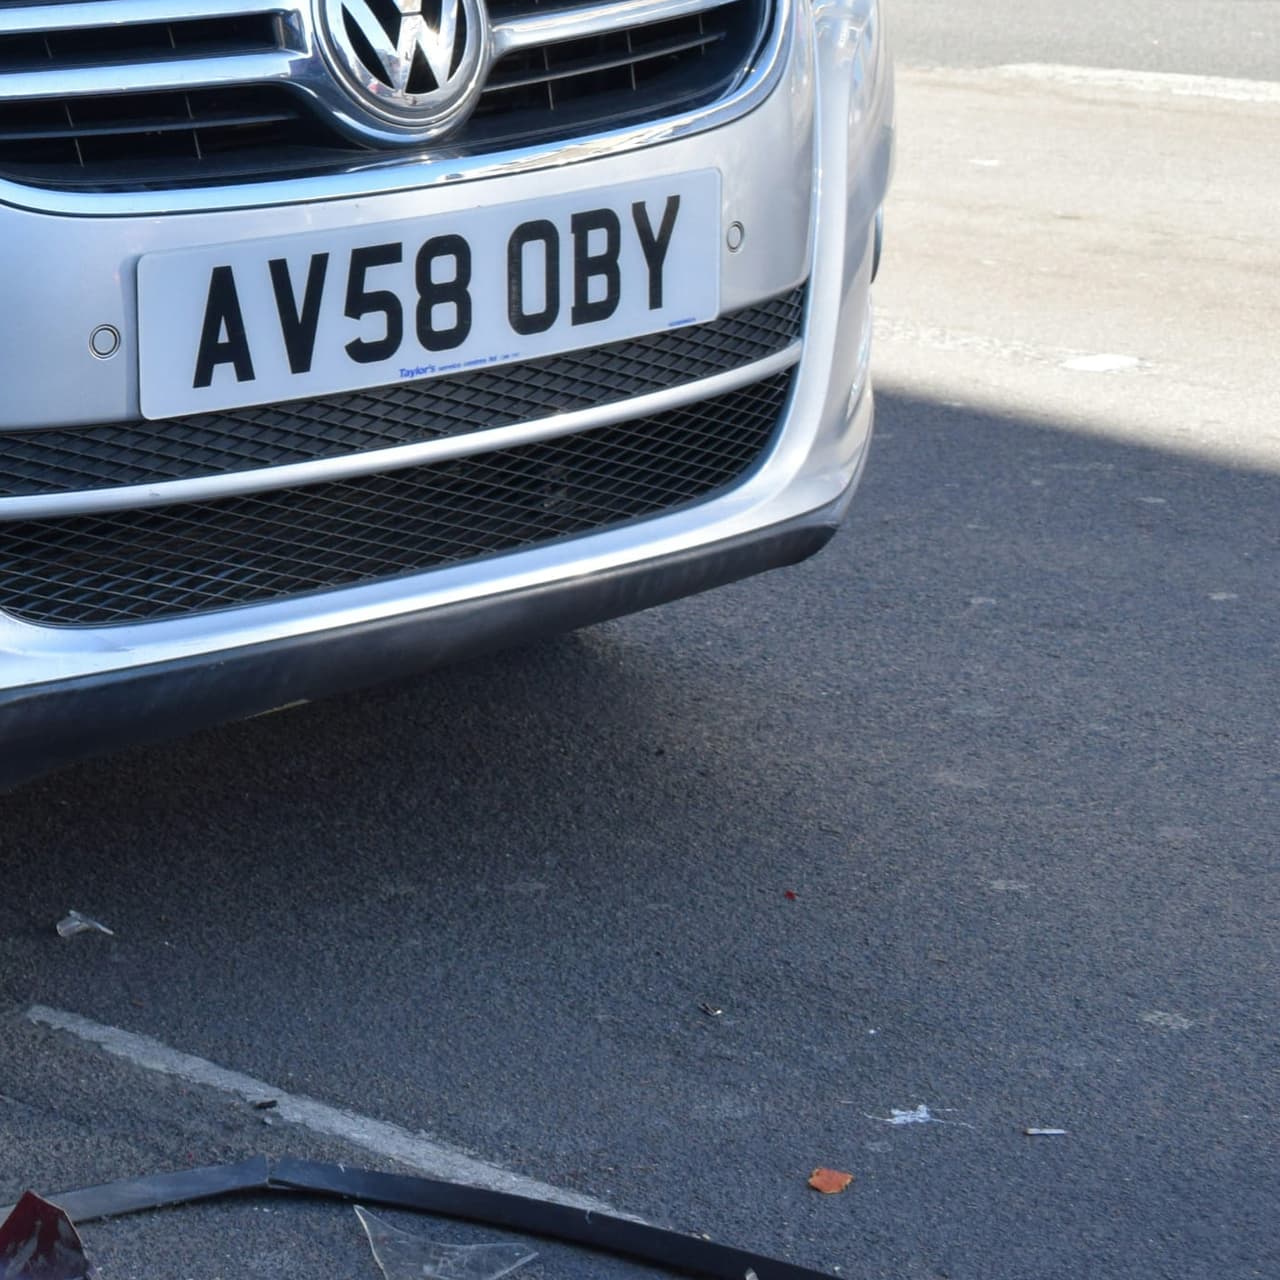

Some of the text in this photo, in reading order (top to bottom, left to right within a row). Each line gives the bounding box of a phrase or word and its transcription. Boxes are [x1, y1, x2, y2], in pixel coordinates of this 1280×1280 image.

[192, 194, 681, 389] AV58 OBY
[399, 364, 435, 378] Taylor's
